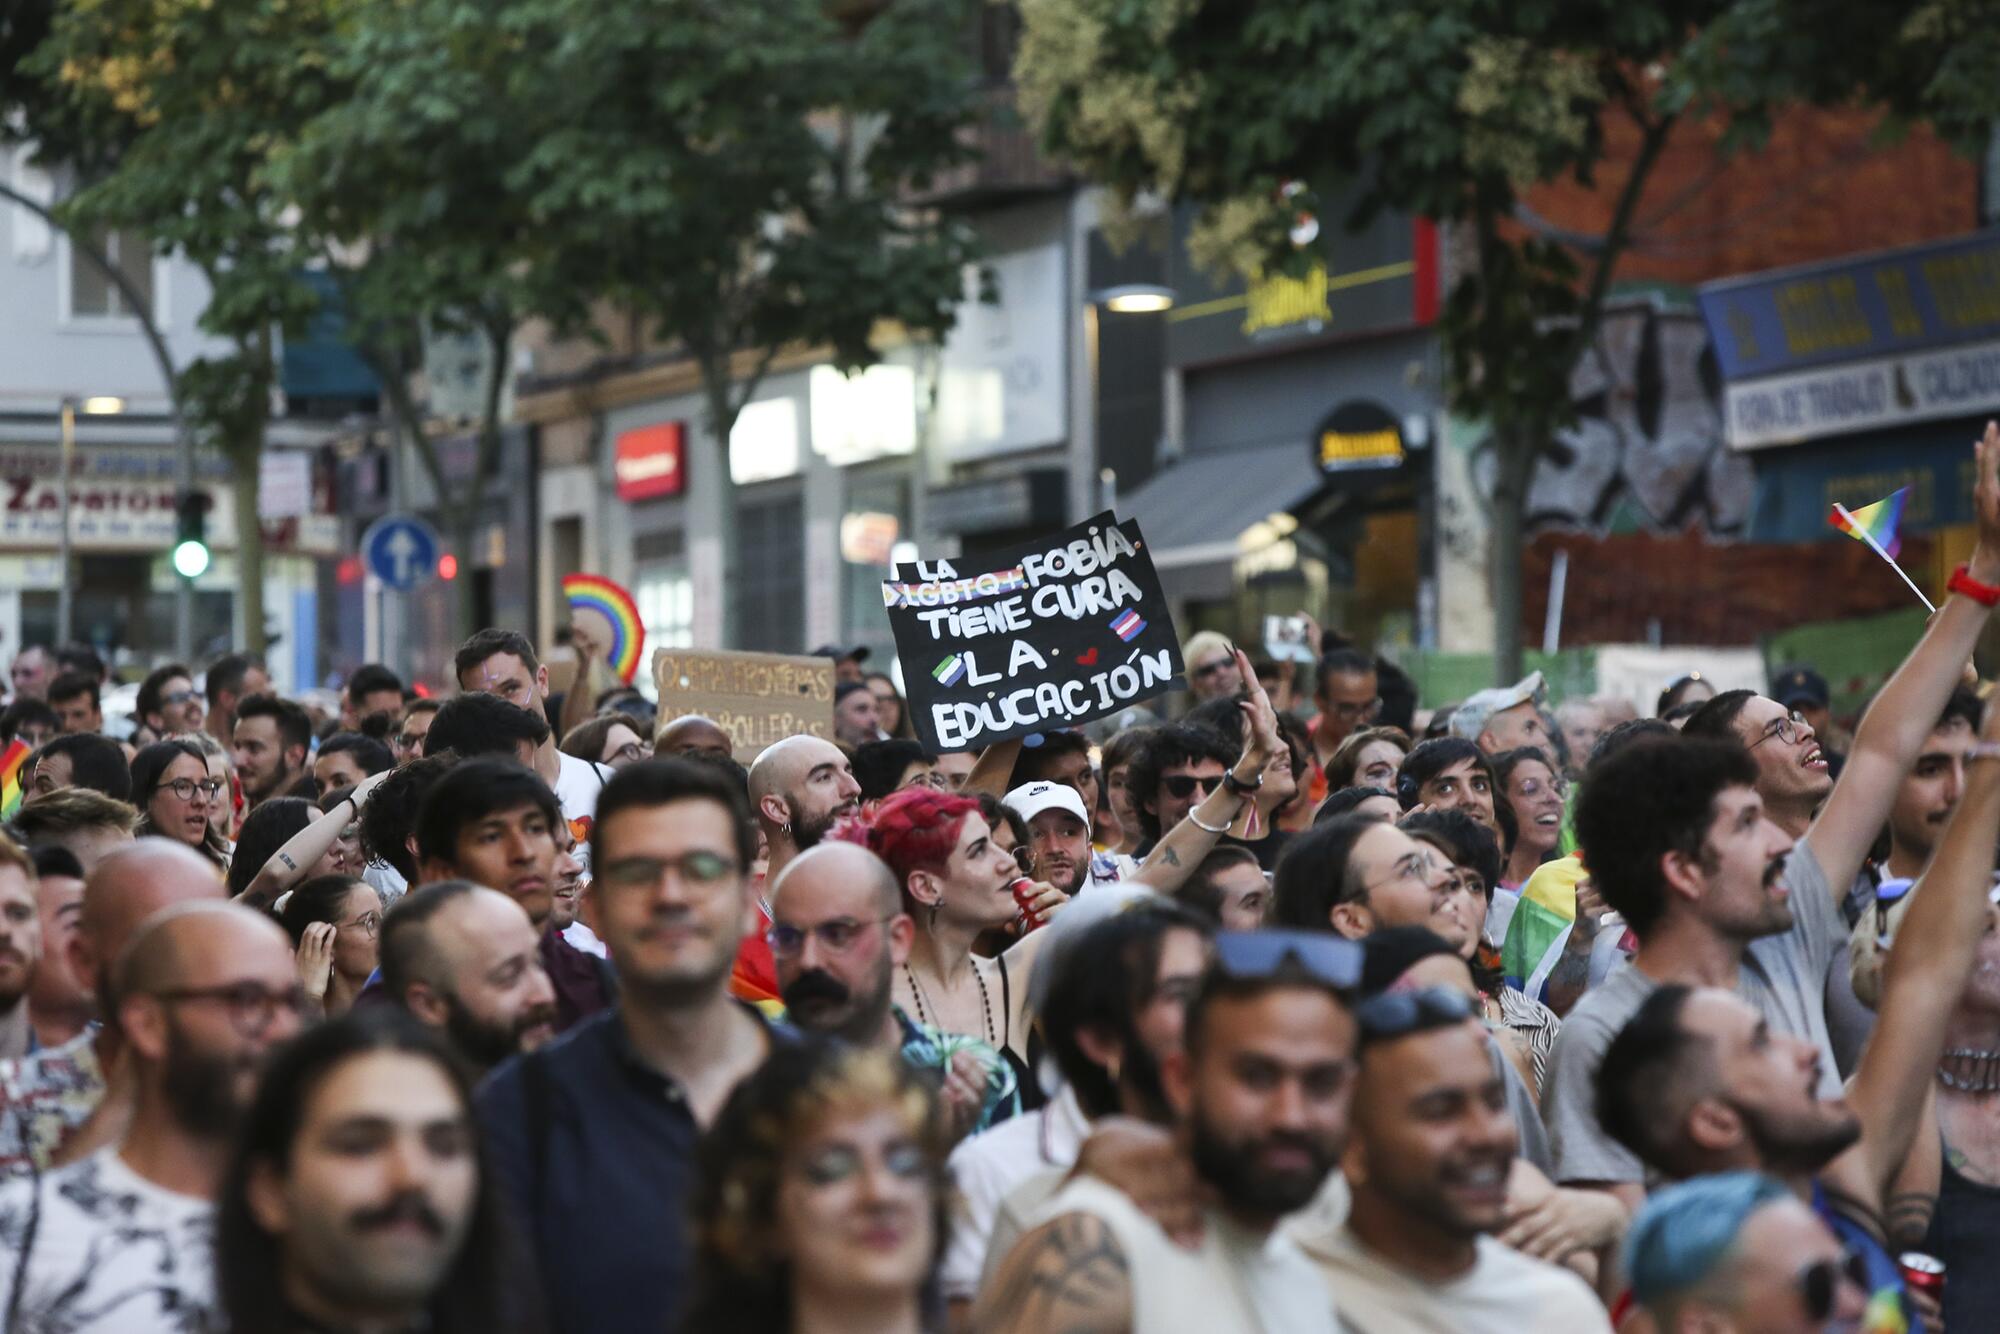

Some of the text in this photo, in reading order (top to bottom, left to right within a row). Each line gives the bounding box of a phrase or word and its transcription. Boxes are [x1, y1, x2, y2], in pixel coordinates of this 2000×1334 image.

[916, 559, 958, 581] LA
[1032, 568, 1142, 620] CURA
[733, 662, 832, 702] FRONTERAS
[963, 639, 1047, 687] LA
[931, 648, 1172, 748] EDUCACIÓN
